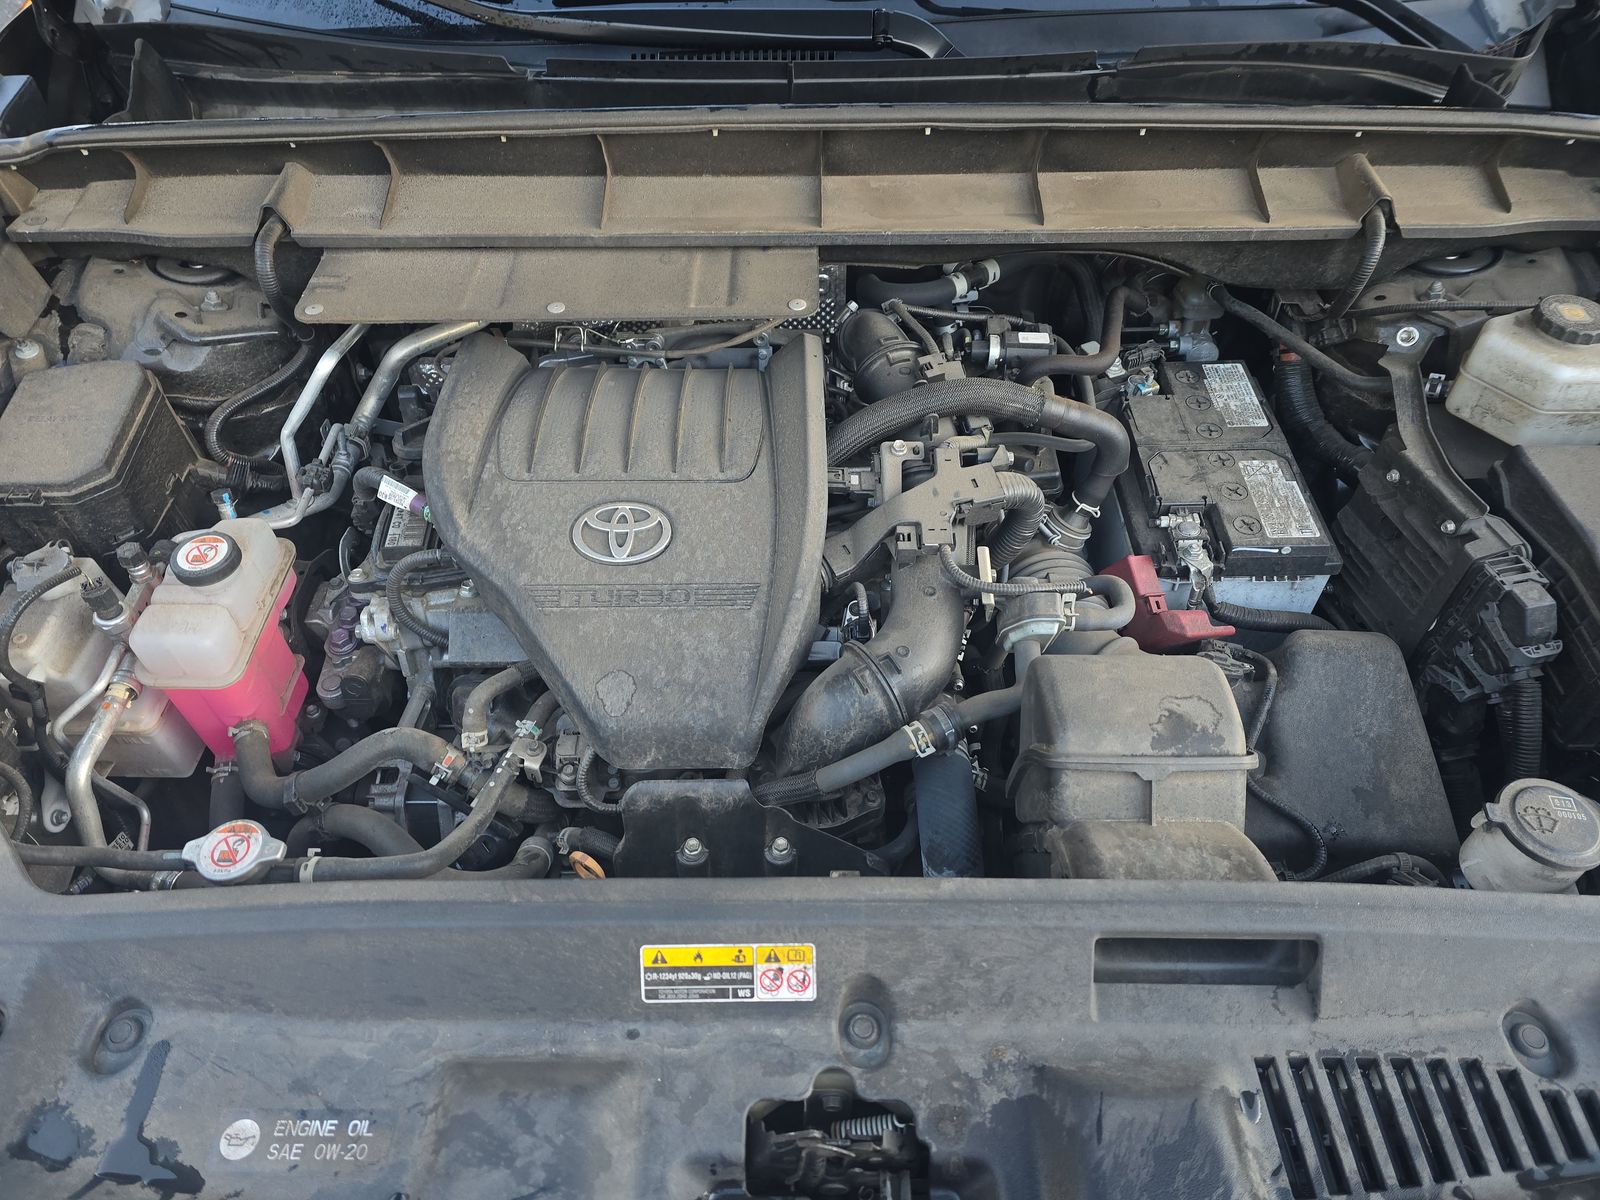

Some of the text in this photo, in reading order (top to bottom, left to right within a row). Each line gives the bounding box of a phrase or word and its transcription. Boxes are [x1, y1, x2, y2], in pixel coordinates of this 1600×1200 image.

[564, 588, 690, 607] TURBO
[737, 989, 751, 998] WS
[273, 1119, 373, 1137] ENGINE OIL
[266, 1143, 368, 1160] SAE 0W-20
